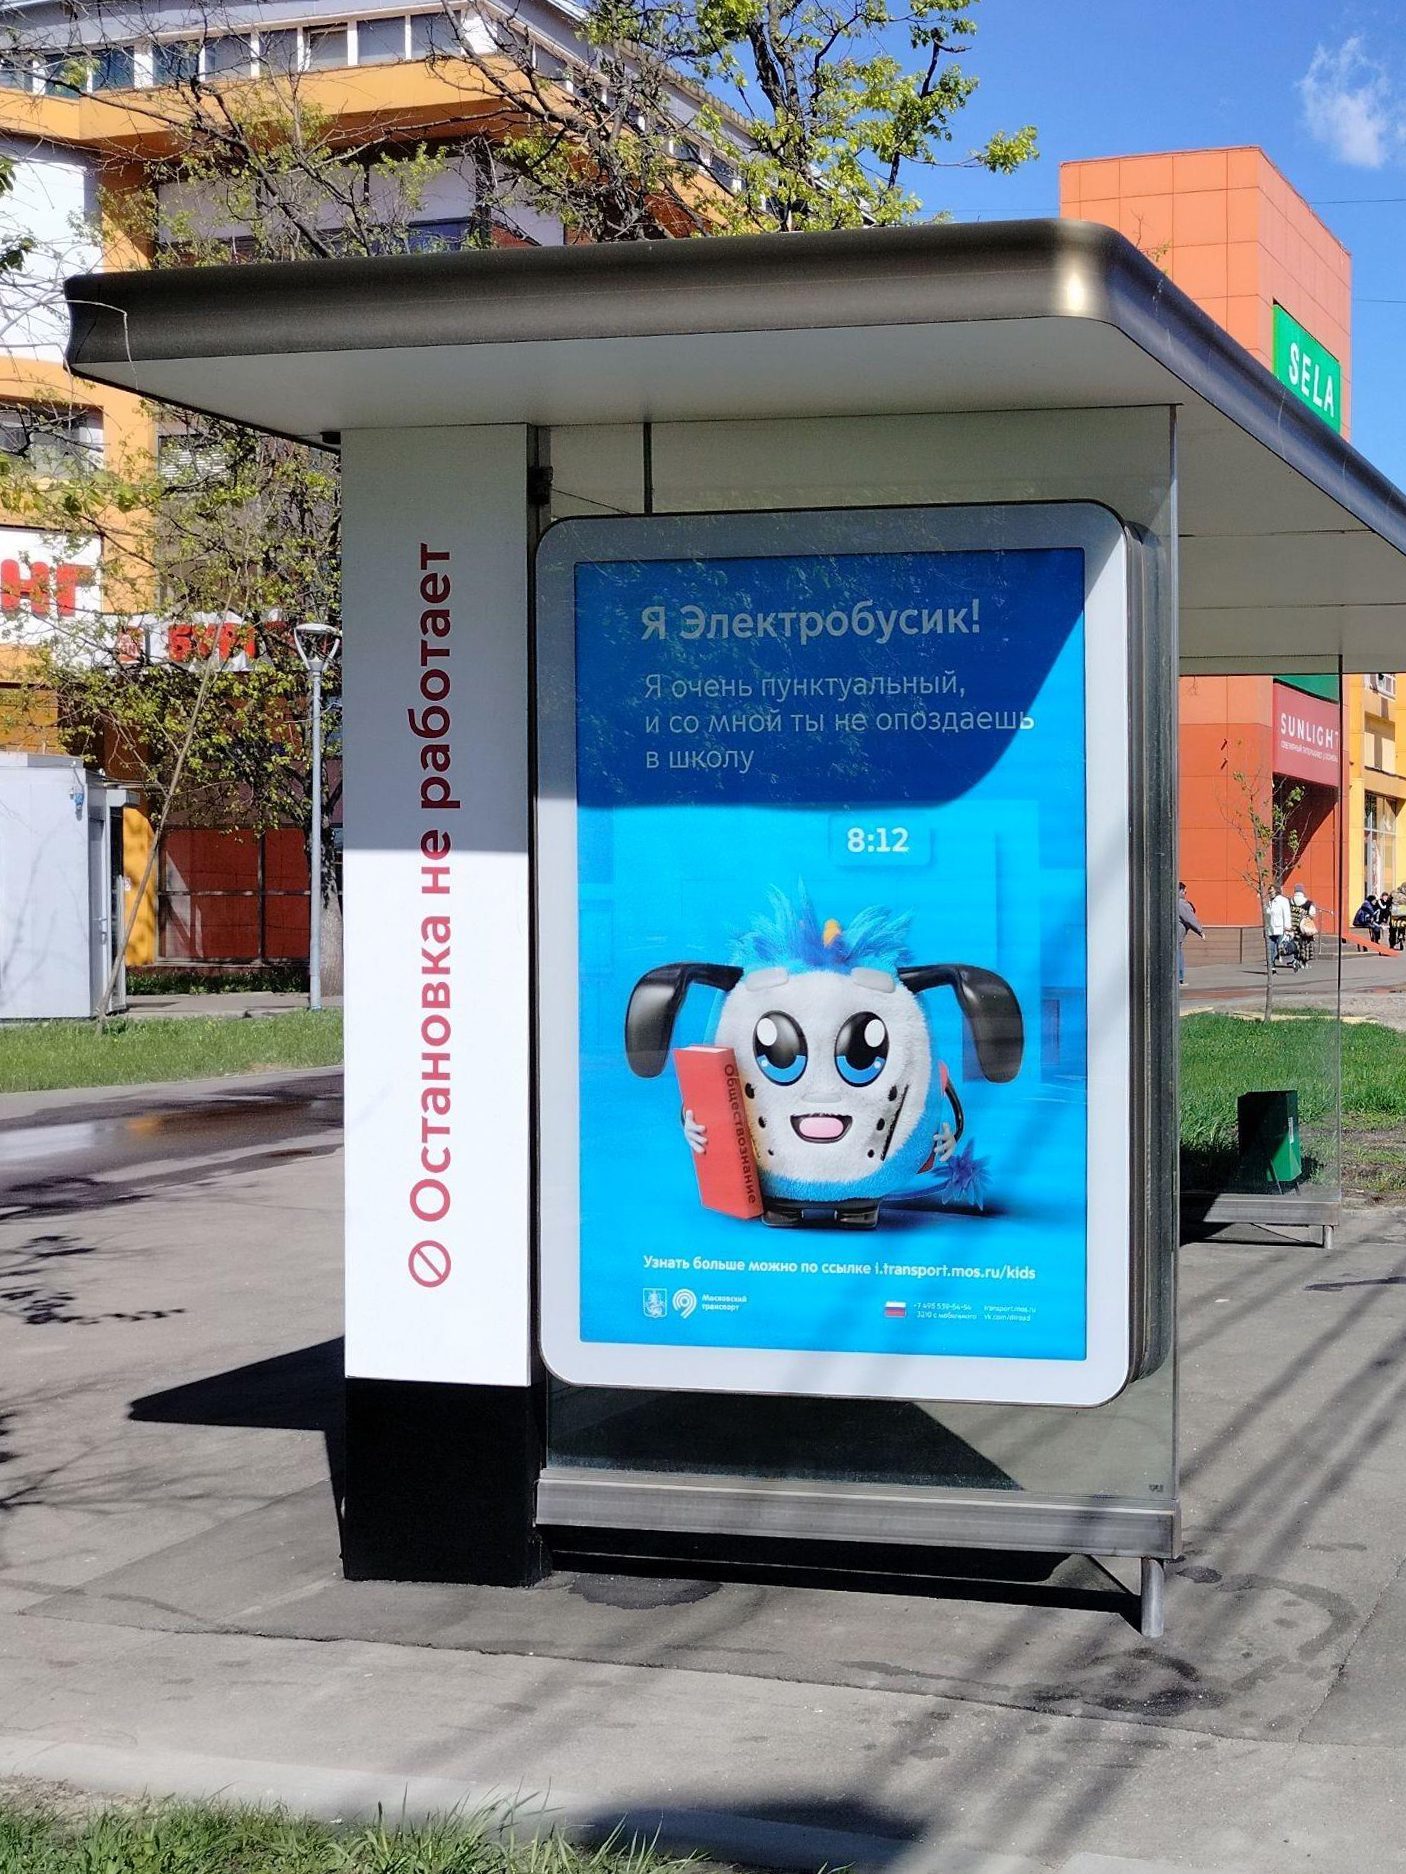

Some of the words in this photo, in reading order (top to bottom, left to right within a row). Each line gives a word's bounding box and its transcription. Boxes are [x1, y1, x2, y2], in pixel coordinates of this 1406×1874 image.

[1288, 342, 1335, 418] SELA
[641, 606, 666, 640] Я
[679, 598, 980, 646] Электробусик!
[407, 542, 461, 810] работает
[645, 673, 662, 699] Я
[671, 678, 753, 698] очень
[761, 669, 966, 703] пунктуальный,
[645, 715, 660, 734] и
[669, 714, 700, 733] со
[708, 707, 782, 733] мной
[790, 713, 824, 732] ты
[835, 713, 868, 732] не
[876, 709, 1035, 734] опоздаешь
[646, 751, 660, 769] в
[669, 748, 755, 773] школу
[847, 826, 911, 853] 8:12
[421, 829, 452, 895] не
[409, 910, 452, 1223] Остановка
[643, 1255, 690, 1269] Узнать
[693, 1256, 745, 1271] больше
[748, 1261, 798, 1272] можно
[801, 1263, 818, 1274] по
[821, 1262, 872, 1275] ссылке
[875, 1262, 1036, 1280] i.transport.mos.ru/kids
[702, 1293, 748, 1303] Московский
[702, 1302, 740, 1312] транспорт
